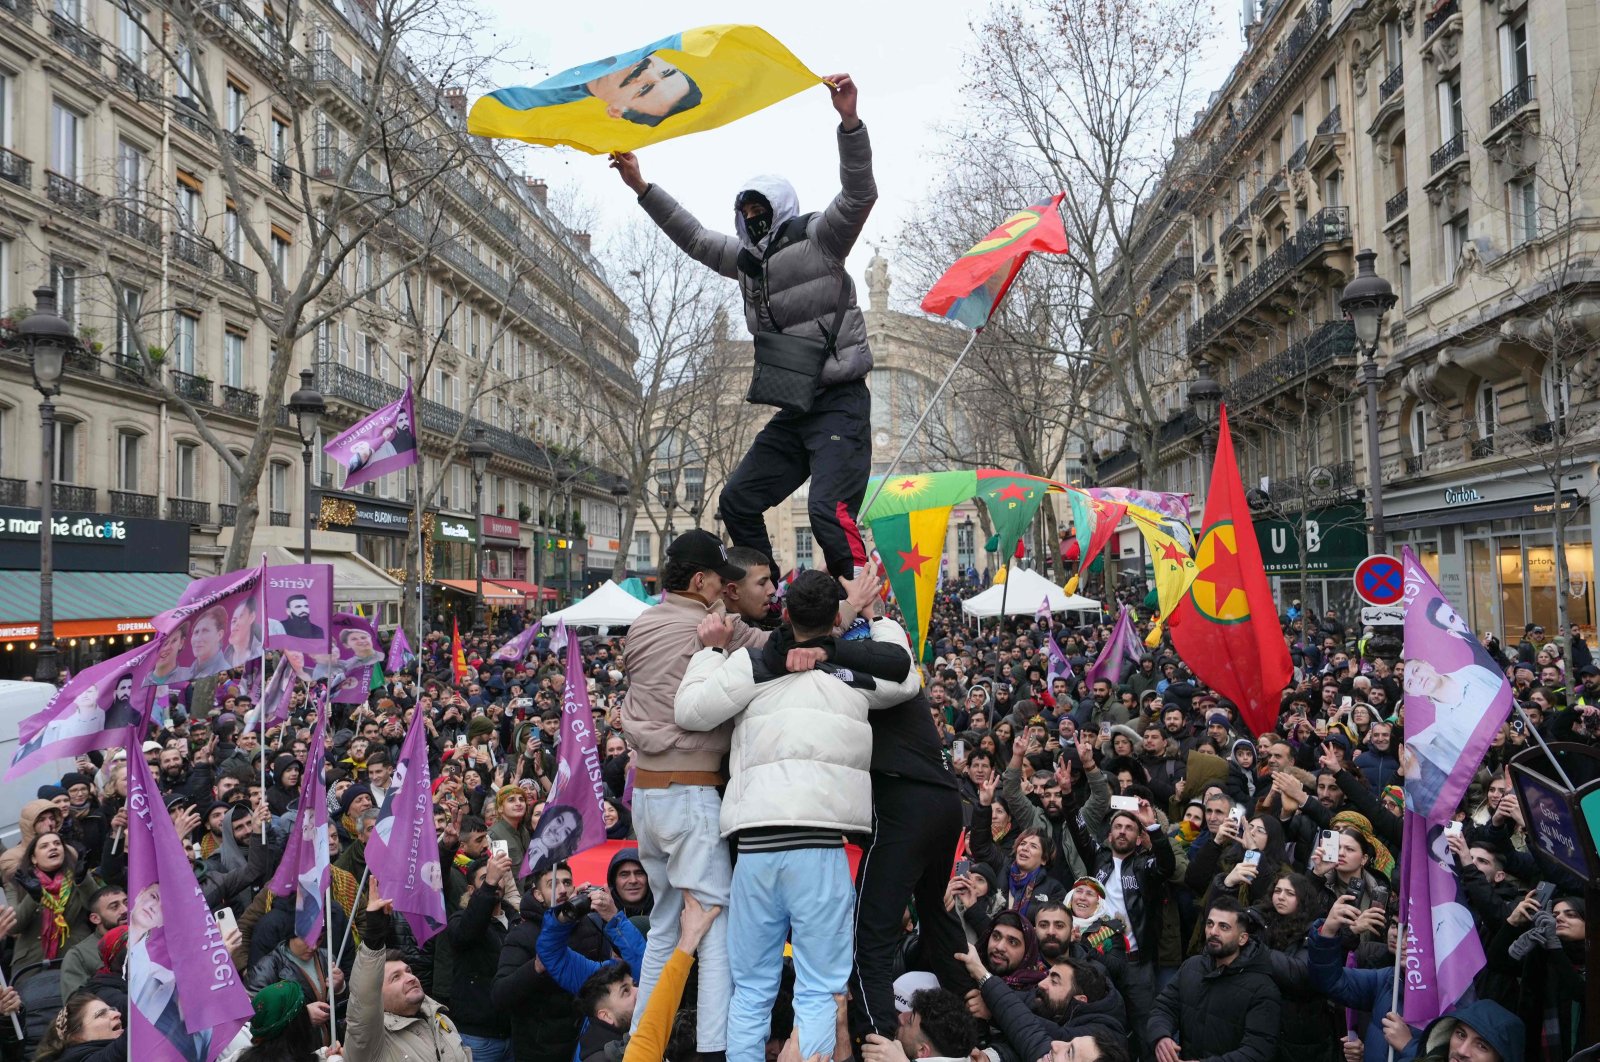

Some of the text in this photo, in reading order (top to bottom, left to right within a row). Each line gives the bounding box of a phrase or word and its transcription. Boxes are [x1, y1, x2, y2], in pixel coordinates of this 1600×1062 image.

[9, 516, 69, 536] marhé
[571, 719, 590, 743] et
[1540, 802, 1561, 824] Gare
[1552, 827, 1575, 851] Nord
